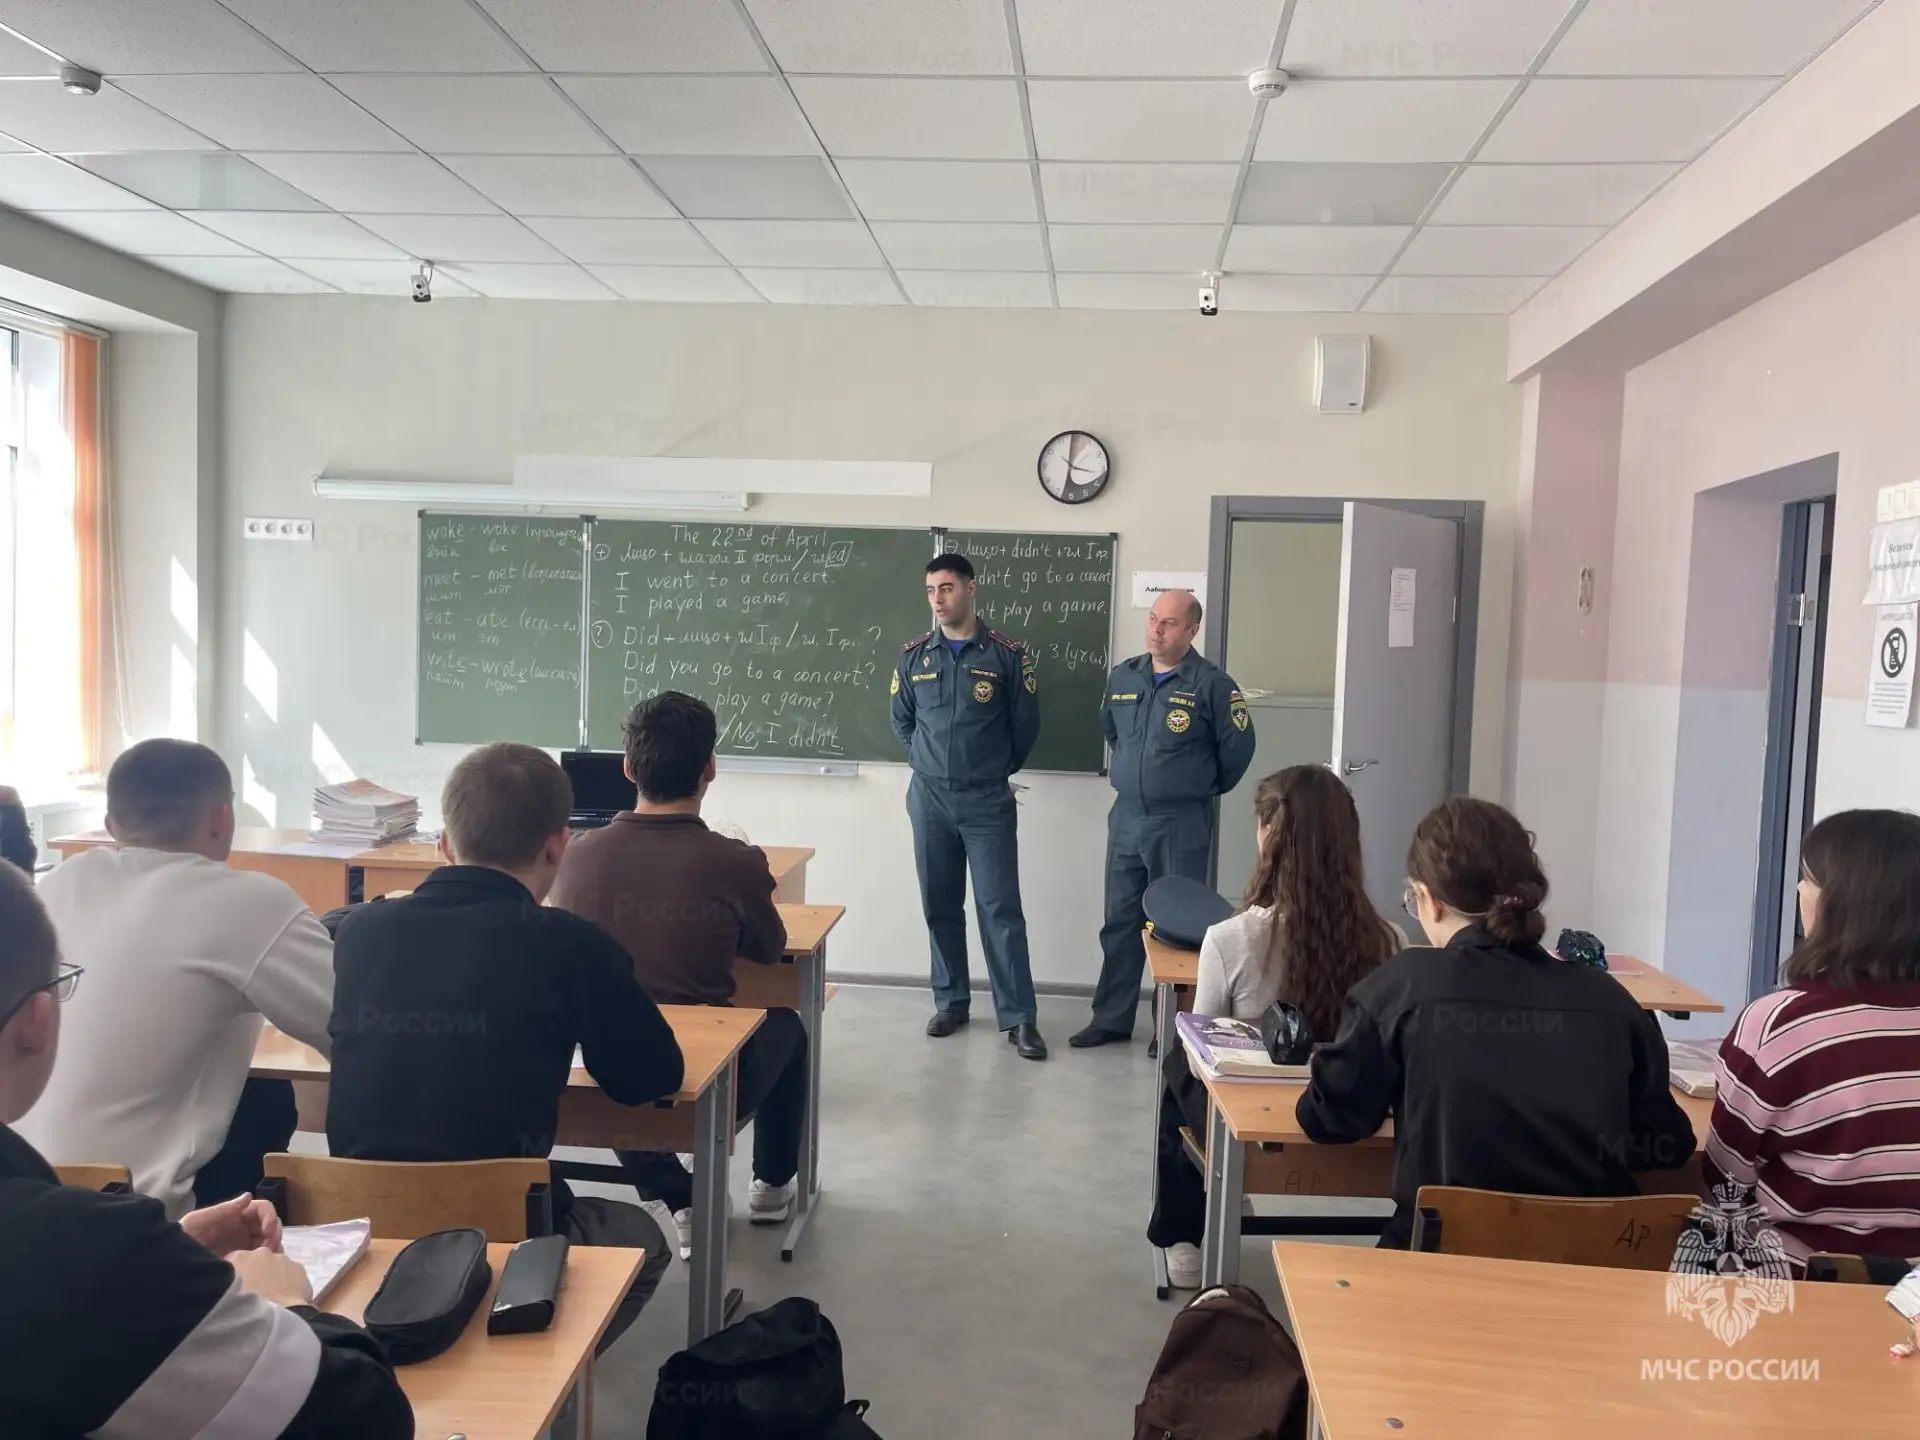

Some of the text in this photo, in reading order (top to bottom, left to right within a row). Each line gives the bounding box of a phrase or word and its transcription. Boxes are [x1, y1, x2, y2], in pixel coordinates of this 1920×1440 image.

[670, 524, 700, 545] The
[760, 525, 781, 547] of
[786, 527, 828, 551] April
[487, 561, 518, 582] met
[613, 571, 631, 591] I
[647, 569, 695, 590] went
[707, 568, 728, 588] to
[741, 573, 751, 584] a
[1020, 570, 1038, 593] go
[1046, 565, 1062, 584] to
[1066, 572, 1075, 583] a
[476, 606, 509, 629] ate
[615, 593, 629, 614] I
[648, 591, 704, 621] played
[716, 597, 728, 608] a
[1003, 599, 1033, 627] play
[1042, 601, 1052, 613] a
[624, 649, 658, 675] Did
[669, 659, 700, 680] you
[708, 660, 732, 686] go
[747, 660, 763, 680] to
[772, 669, 782, 681] a
[714, 683, 752, 715] play
[761, 691, 771, 706] a
[765, 720, 782, 744] I
